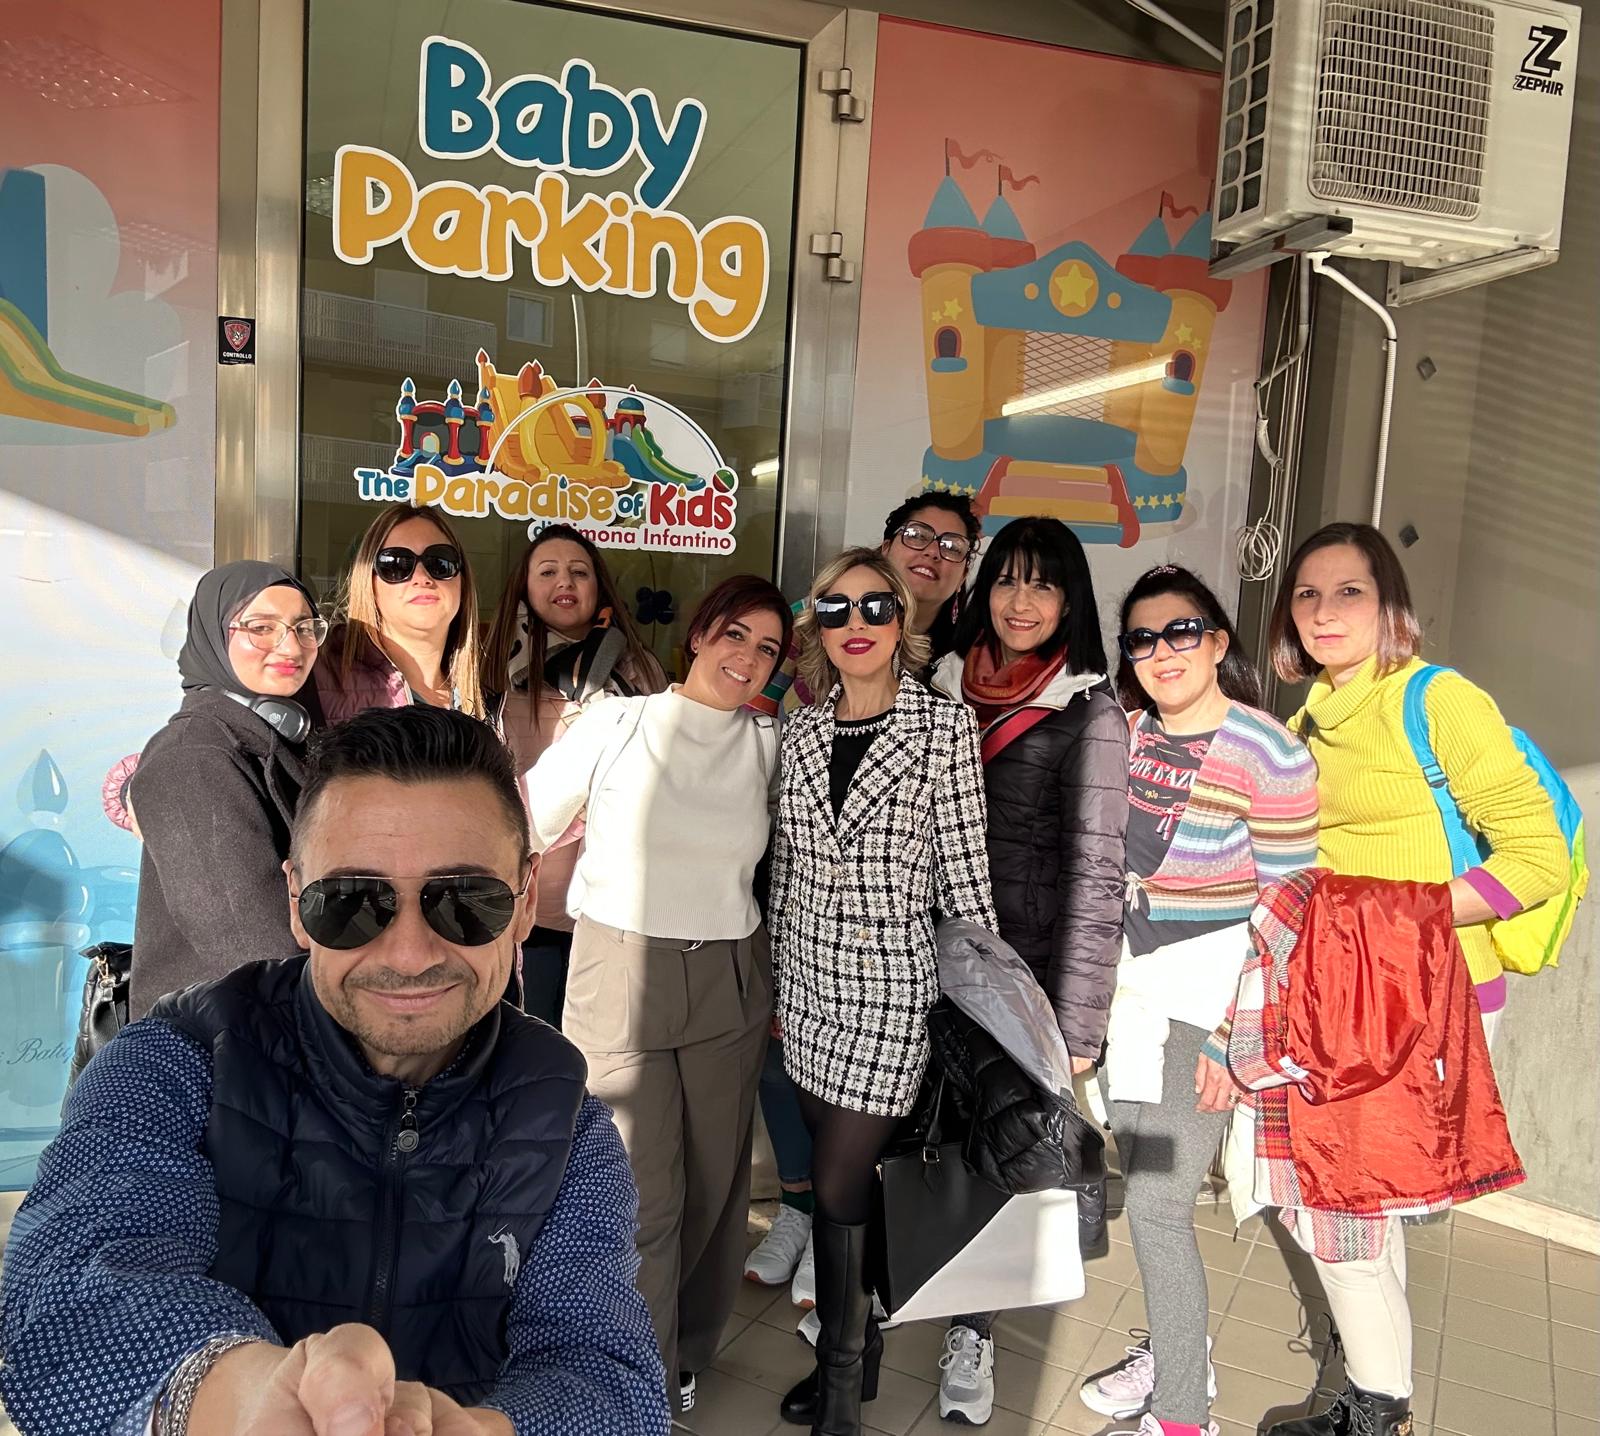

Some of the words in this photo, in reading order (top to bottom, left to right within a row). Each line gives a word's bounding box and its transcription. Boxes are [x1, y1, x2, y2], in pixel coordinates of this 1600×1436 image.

[1512, 74, 1564, 96] ZEPHIR
[420, 36, 707, 210] Baby
[334, 145, 769, 342] Parking
[222, 351, 252, 359] CONTROLLO
[357, 470, 410, 497] The
[415, 464, 615, 521] Paradise
[618, 493, 645, 516] of
[650, 483, 735, 531] Kids
[643, 528, 732, 550] Infantino
